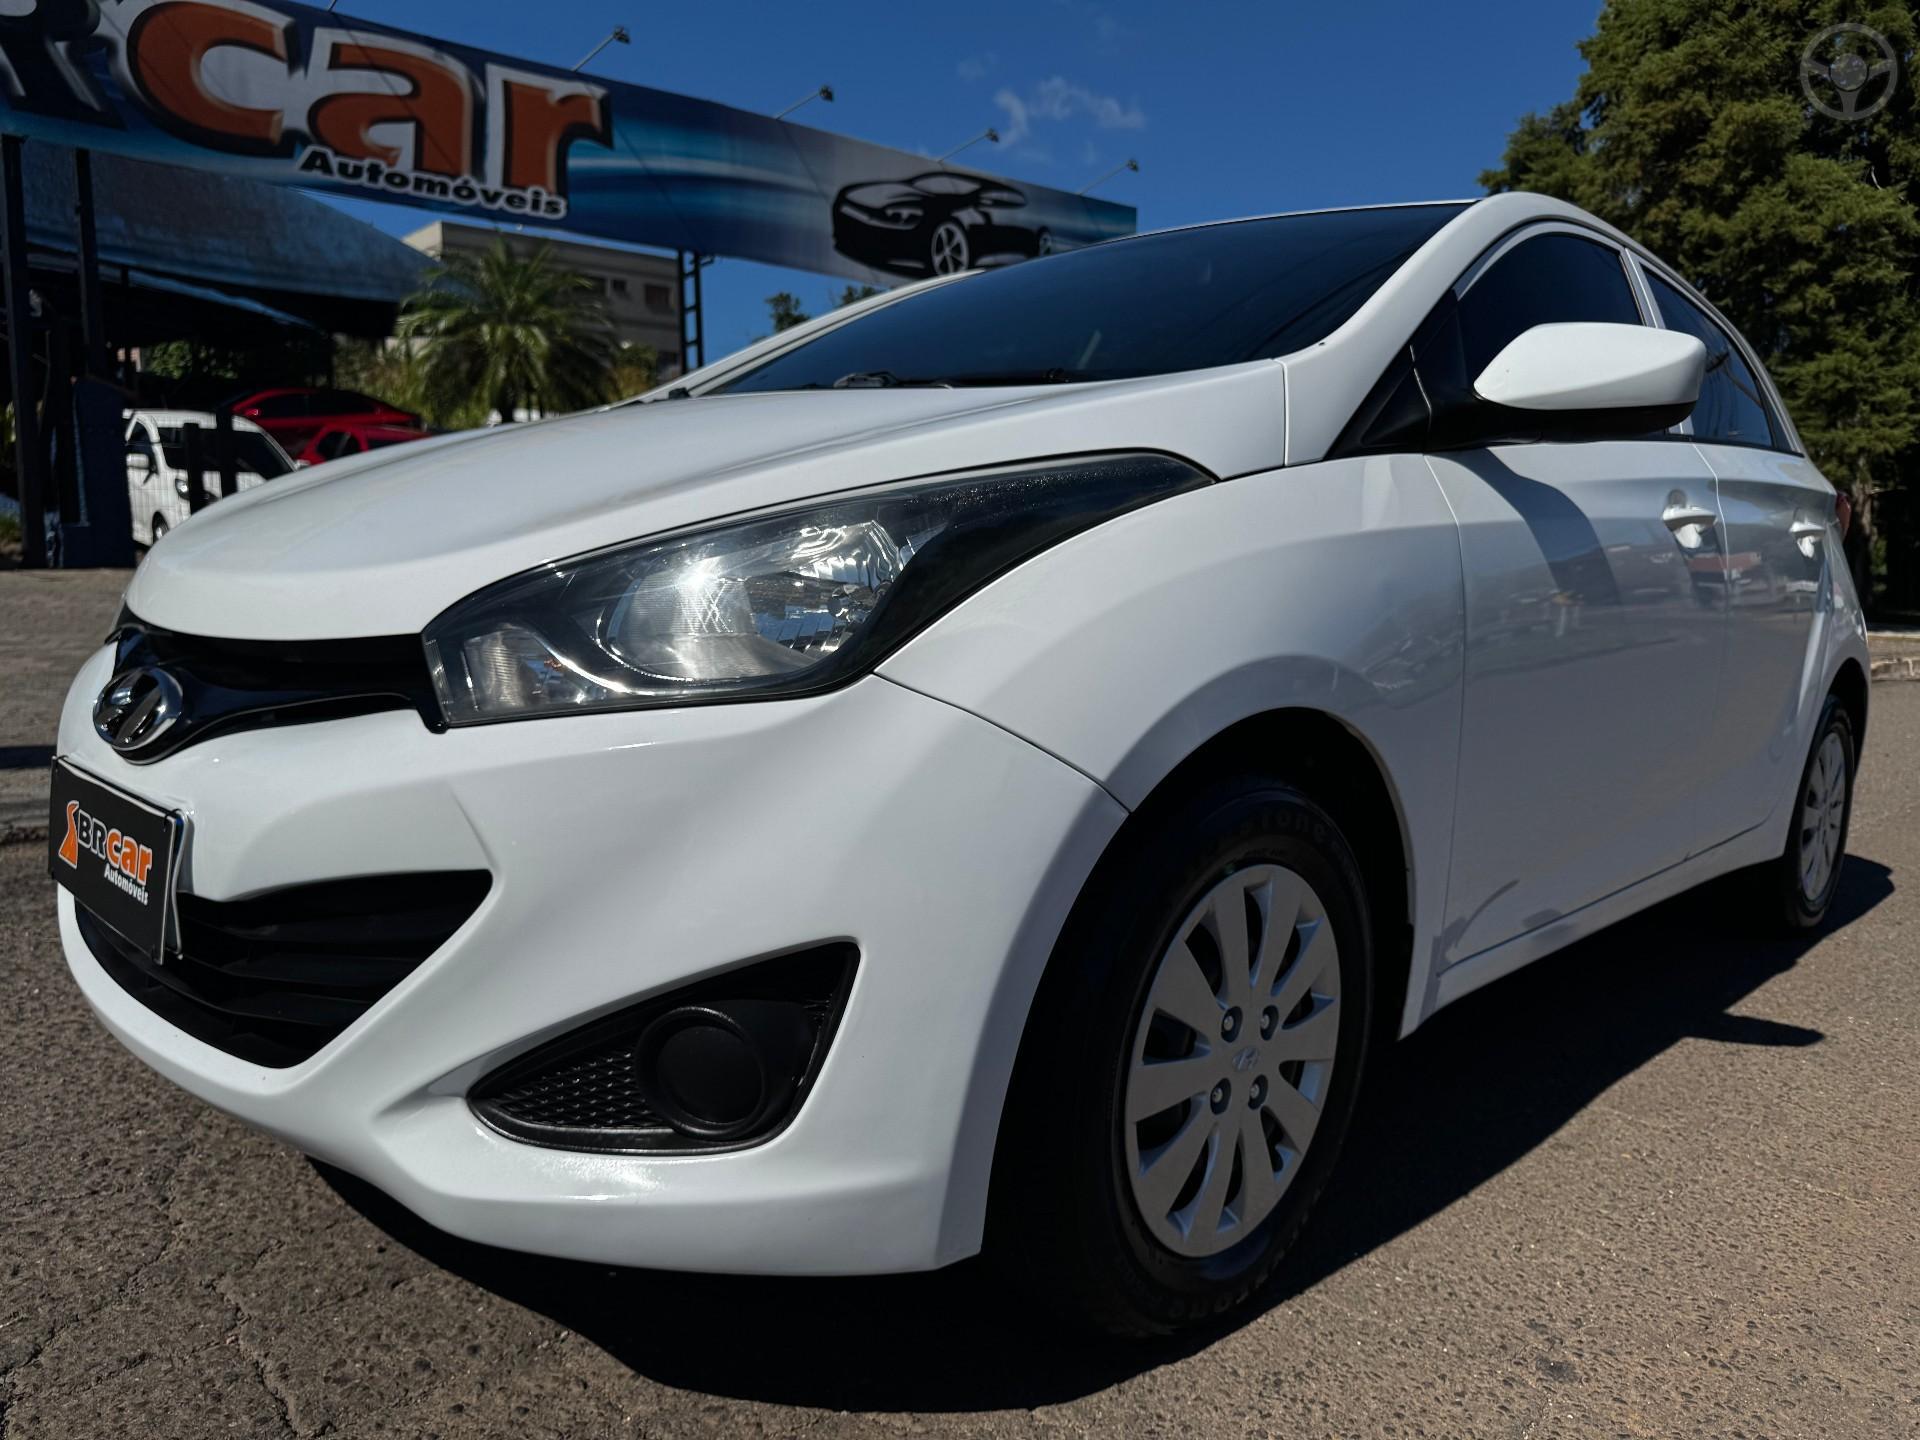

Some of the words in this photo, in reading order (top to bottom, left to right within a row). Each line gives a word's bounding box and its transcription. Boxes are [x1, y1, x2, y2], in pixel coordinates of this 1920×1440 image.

[298, 147, 565, 218] Automóveis
[78, 808, 153, 886] BRcar
[104, 862, 149, 906] Automóveis
